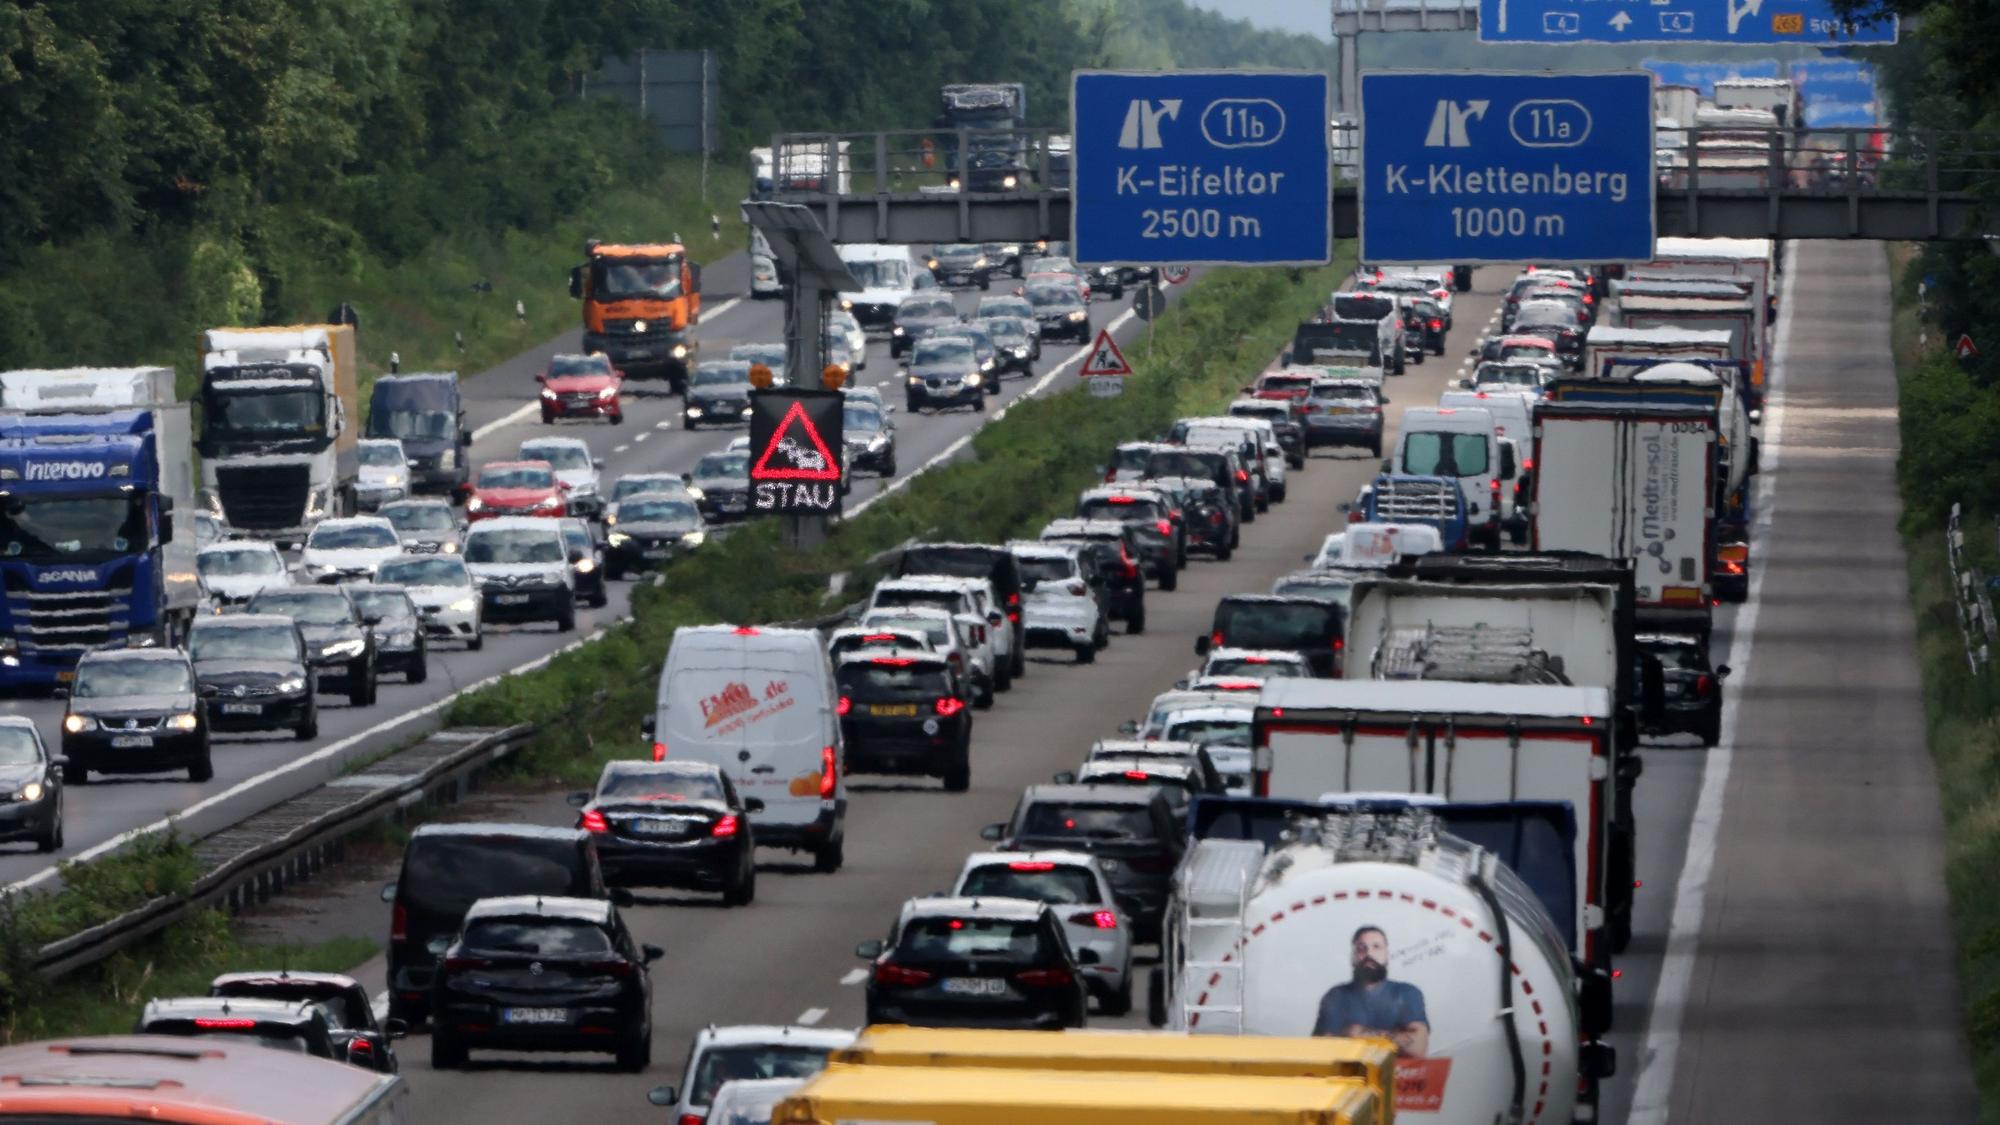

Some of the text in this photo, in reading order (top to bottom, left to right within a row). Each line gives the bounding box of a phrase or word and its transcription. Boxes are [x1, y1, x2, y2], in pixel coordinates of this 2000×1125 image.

[1222, 107, 1265, 138] 11b
[1530, 108, 1571, 138] 11a
[1116, 165, 1284, 195] K-Eifeltor
[1386, 163, 1627, 201] K-Klettenberg
[1142, 208, 1261, 238] 2500 m
[1452, 207, 1565, 237] 1000 m
[756, 482, 834, 509] STAU
[38, 570, 98, 583] SCANIA
